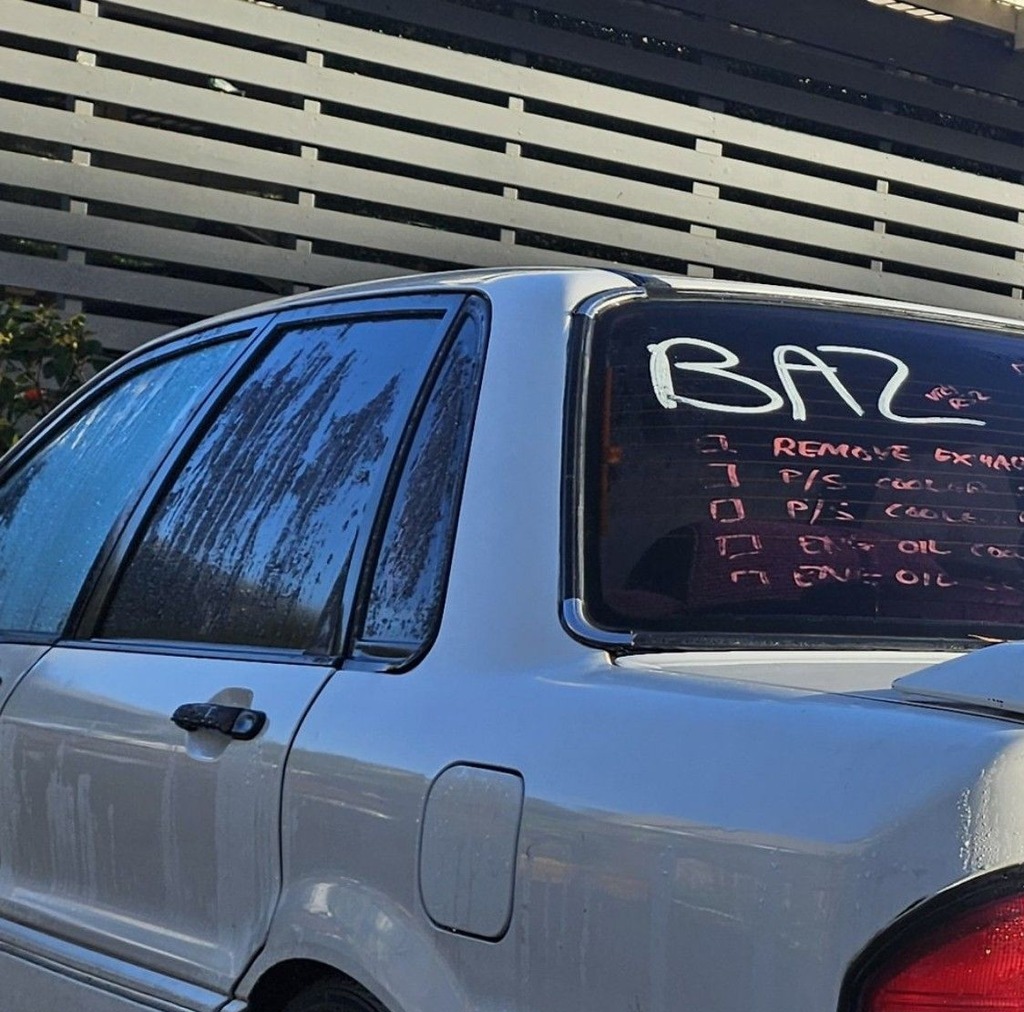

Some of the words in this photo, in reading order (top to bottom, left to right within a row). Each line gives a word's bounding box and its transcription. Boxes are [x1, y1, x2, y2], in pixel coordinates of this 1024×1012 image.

[647, 337, 986, 426] BAZ
[773, 437, 911, 462] REMOVE
[898, 539, 952, 555] OIL
[895, 568, 959, 588] OIL
